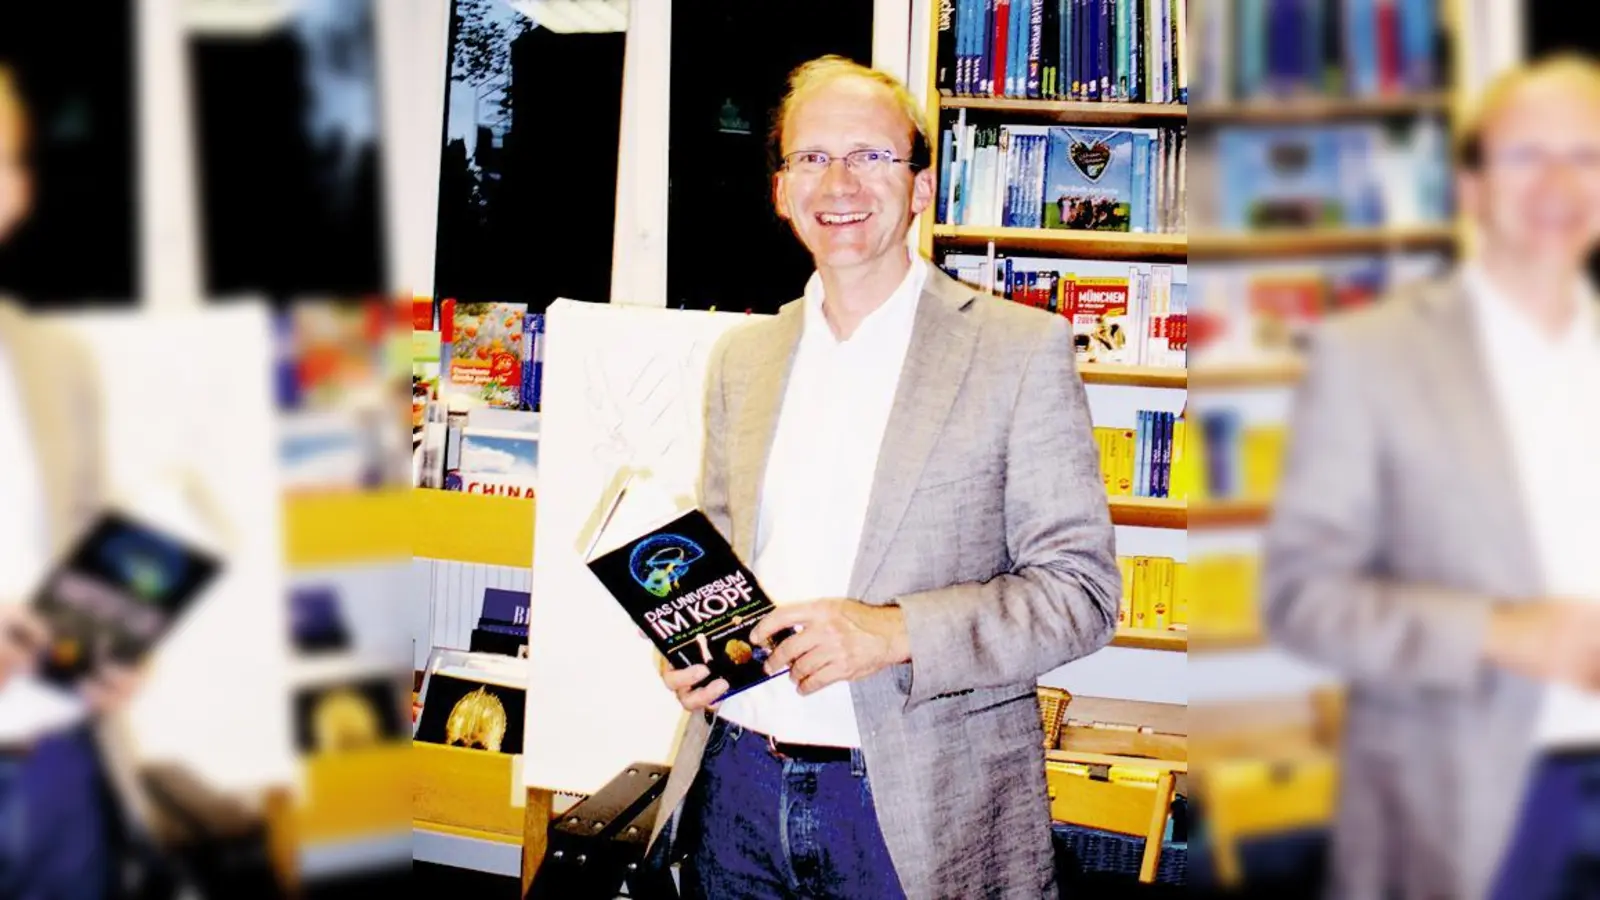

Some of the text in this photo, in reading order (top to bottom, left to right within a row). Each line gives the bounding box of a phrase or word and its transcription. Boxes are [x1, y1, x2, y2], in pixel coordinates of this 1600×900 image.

[1078, 289, 1126, 304] MÜNCHEN
[468, 482, 535, 499] CHINA
[643, 570, 746, 623] DAS UNIVERSUM
[651, 610, 690, 640] IM
[686, 581, 753, 623] KOPF
